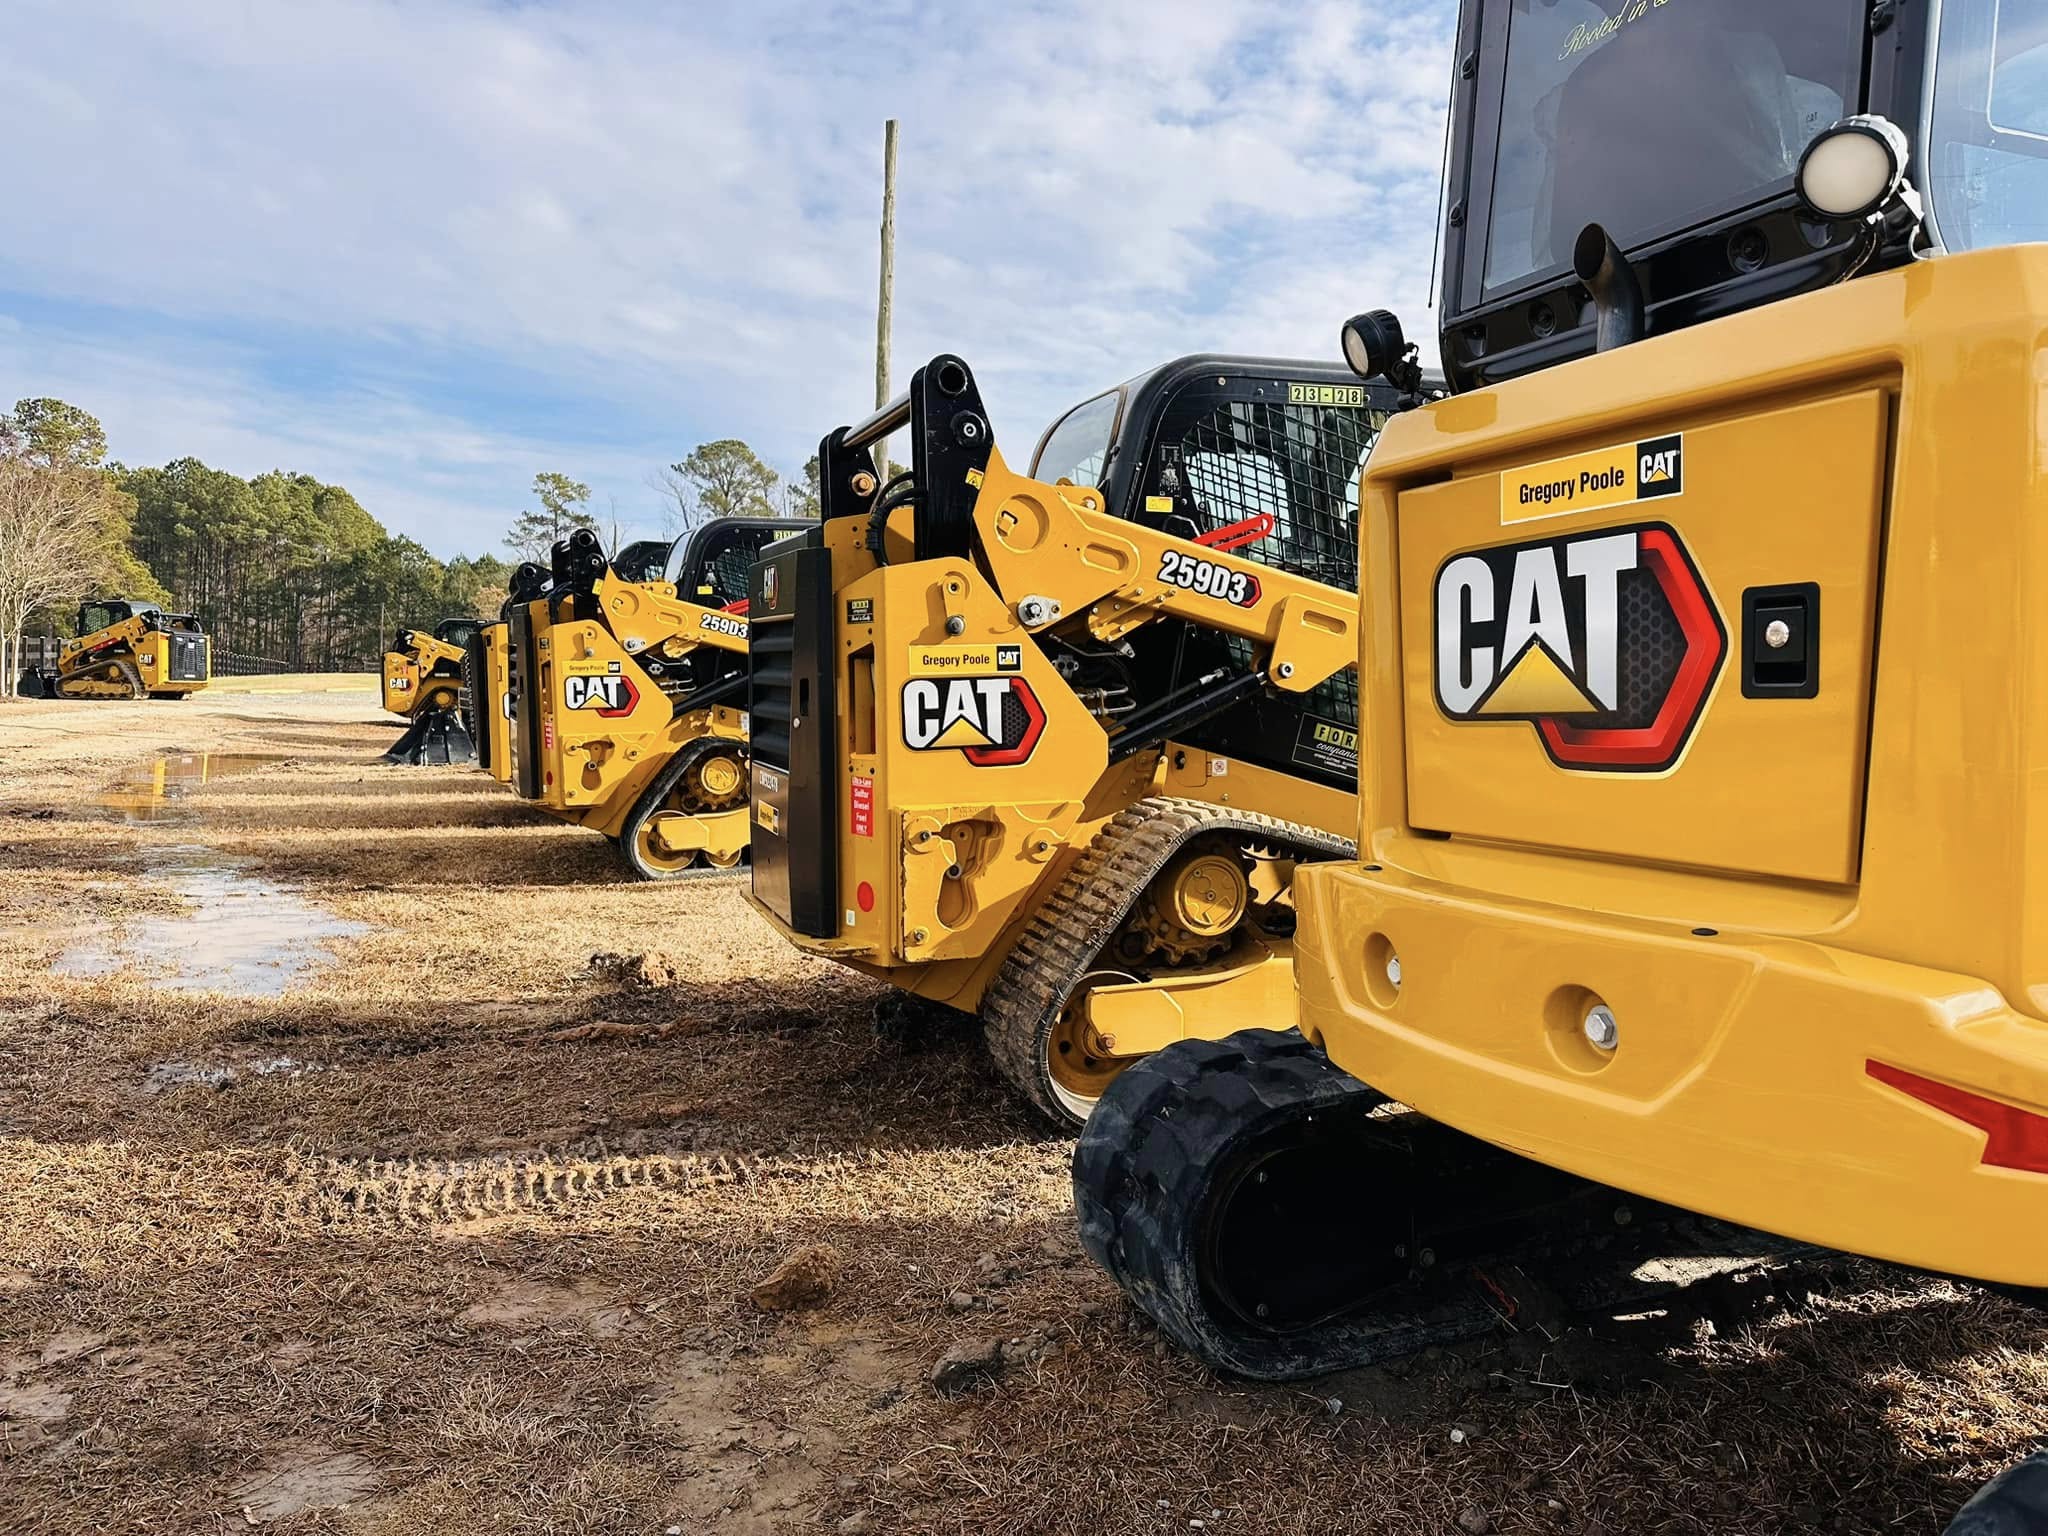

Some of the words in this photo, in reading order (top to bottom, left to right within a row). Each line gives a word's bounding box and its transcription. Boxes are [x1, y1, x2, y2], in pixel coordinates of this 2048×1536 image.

[1558, 0, 1630, 60] Rooted
[1628, 0, 1648, 22] in
[1294, 387, 1359, 403] 23-28
[1519, 479, 1576, 505] Gregory
[1580, 466, 1625, 493] Poole
[1640, 450, 1677, 484] CAT
[1158, 551, 1248, 603] 259D3
[700, 613, 748, 638] 259D3
[1438, 532, 1637, 714] CAT
[138, 654, 153, 664] CAT
[922, 654, 960, 667] Gregory
[962, 654, 990, 665] Poole
[998, 651, 1019, 665] CAT
[389, 677, 408, 689] CAT
[565, 676, 622, 709] CAT
[903, 678, 1011, 749] CAT
[1318, 726, 1358, 748] FOR
